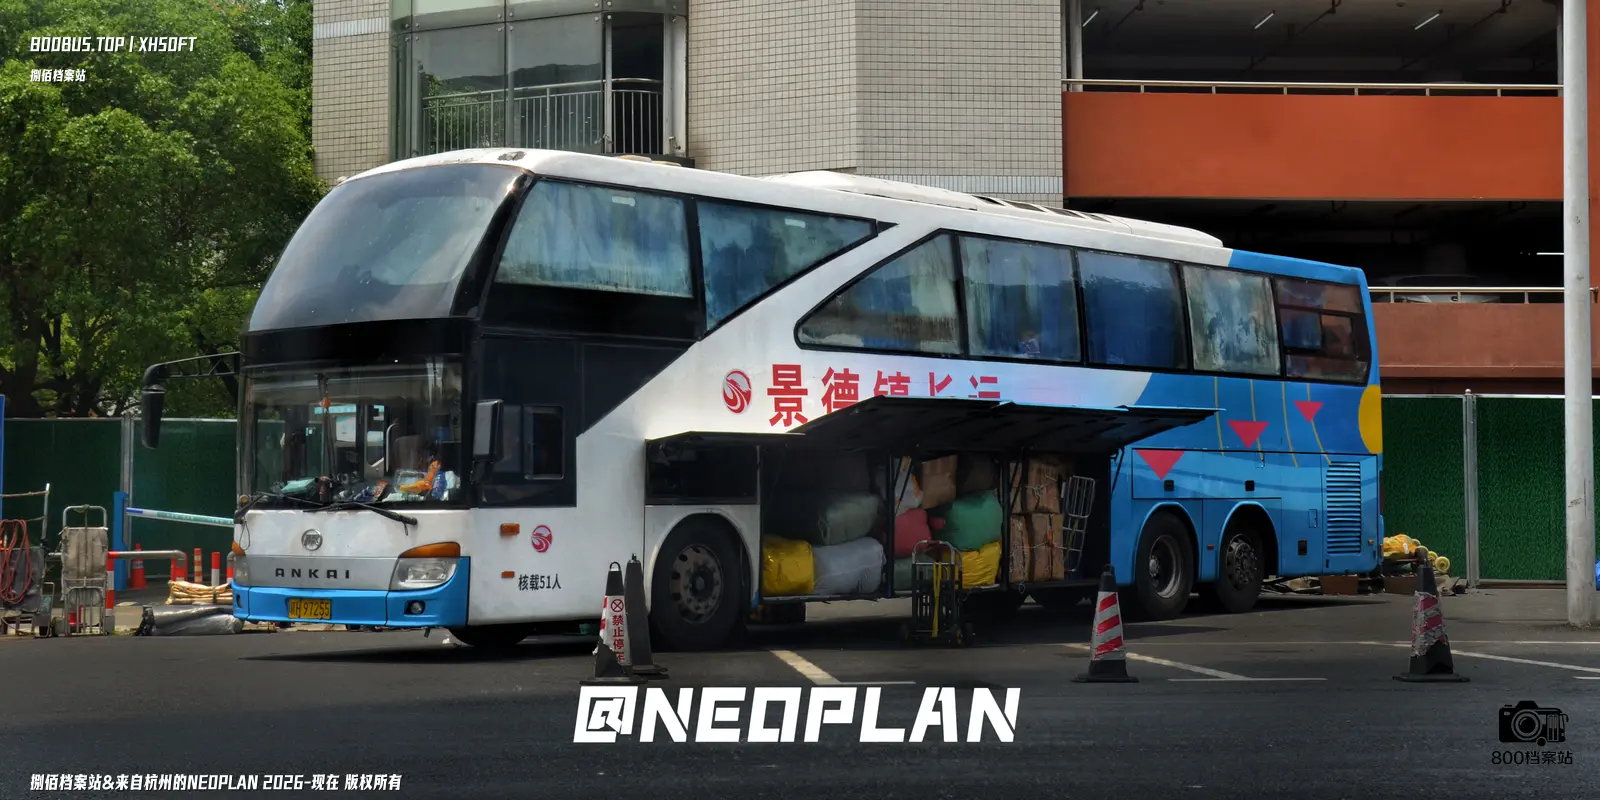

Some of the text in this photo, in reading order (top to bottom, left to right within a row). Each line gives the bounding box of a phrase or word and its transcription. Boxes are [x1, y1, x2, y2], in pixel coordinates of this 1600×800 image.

[275, 567, 350, 579] ANKAI
[518, 573, 562, 591] 核载51人
